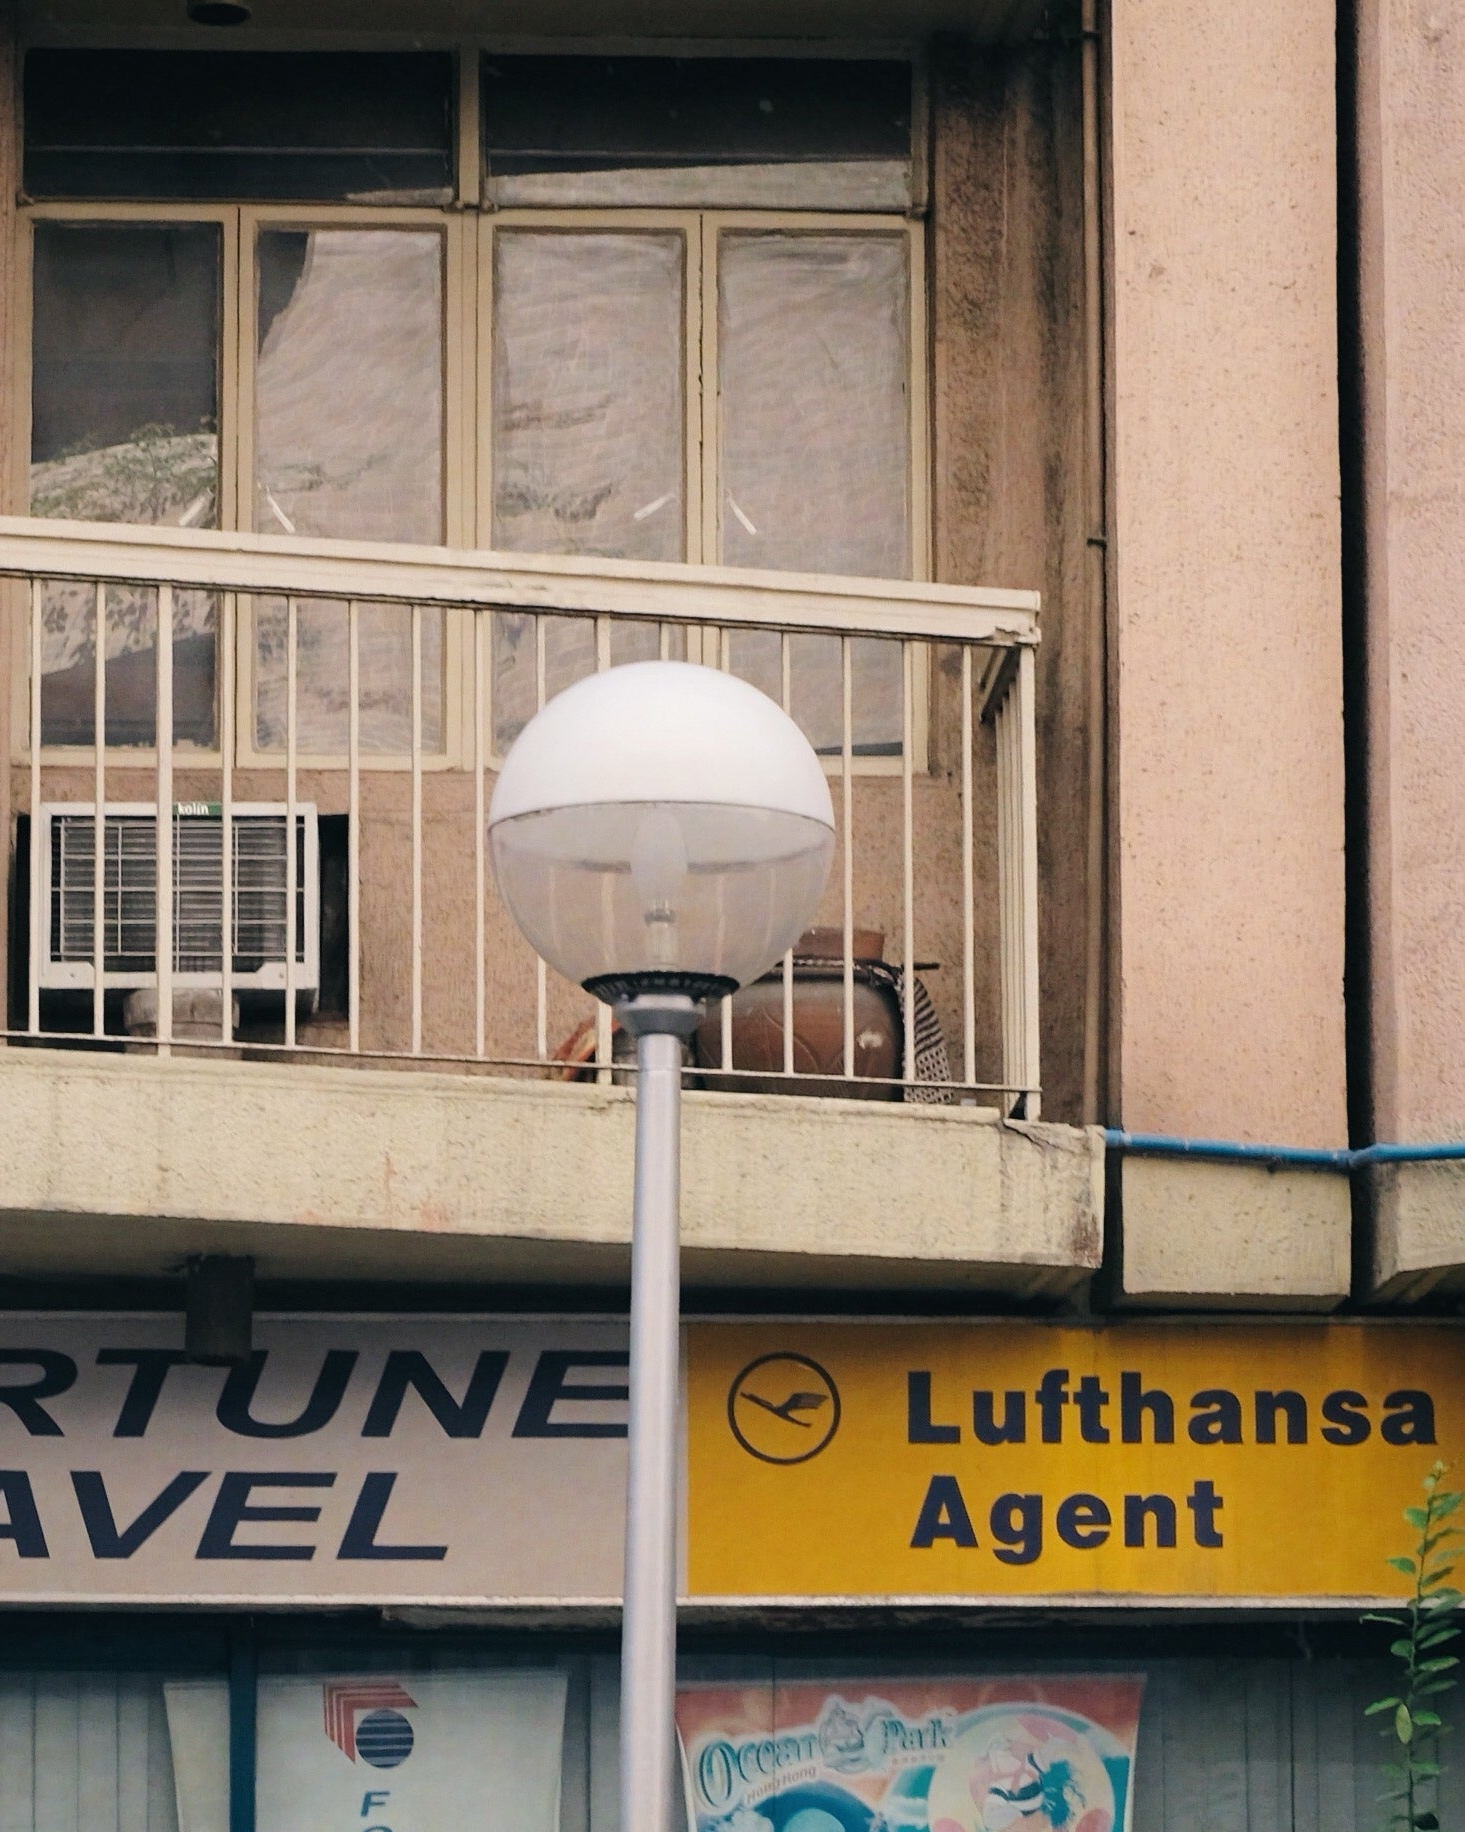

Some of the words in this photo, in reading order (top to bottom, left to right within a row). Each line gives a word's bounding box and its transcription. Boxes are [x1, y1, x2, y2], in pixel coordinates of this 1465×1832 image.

[177, 801, 209, 815] kolin
[908, 1369, 1438, 1446] Lufthansa
[910, 1475, 1223, 1565] Agent
[699, 1732, 818, 1808] Ocean
[882, 1716, 948, 1754] Park
